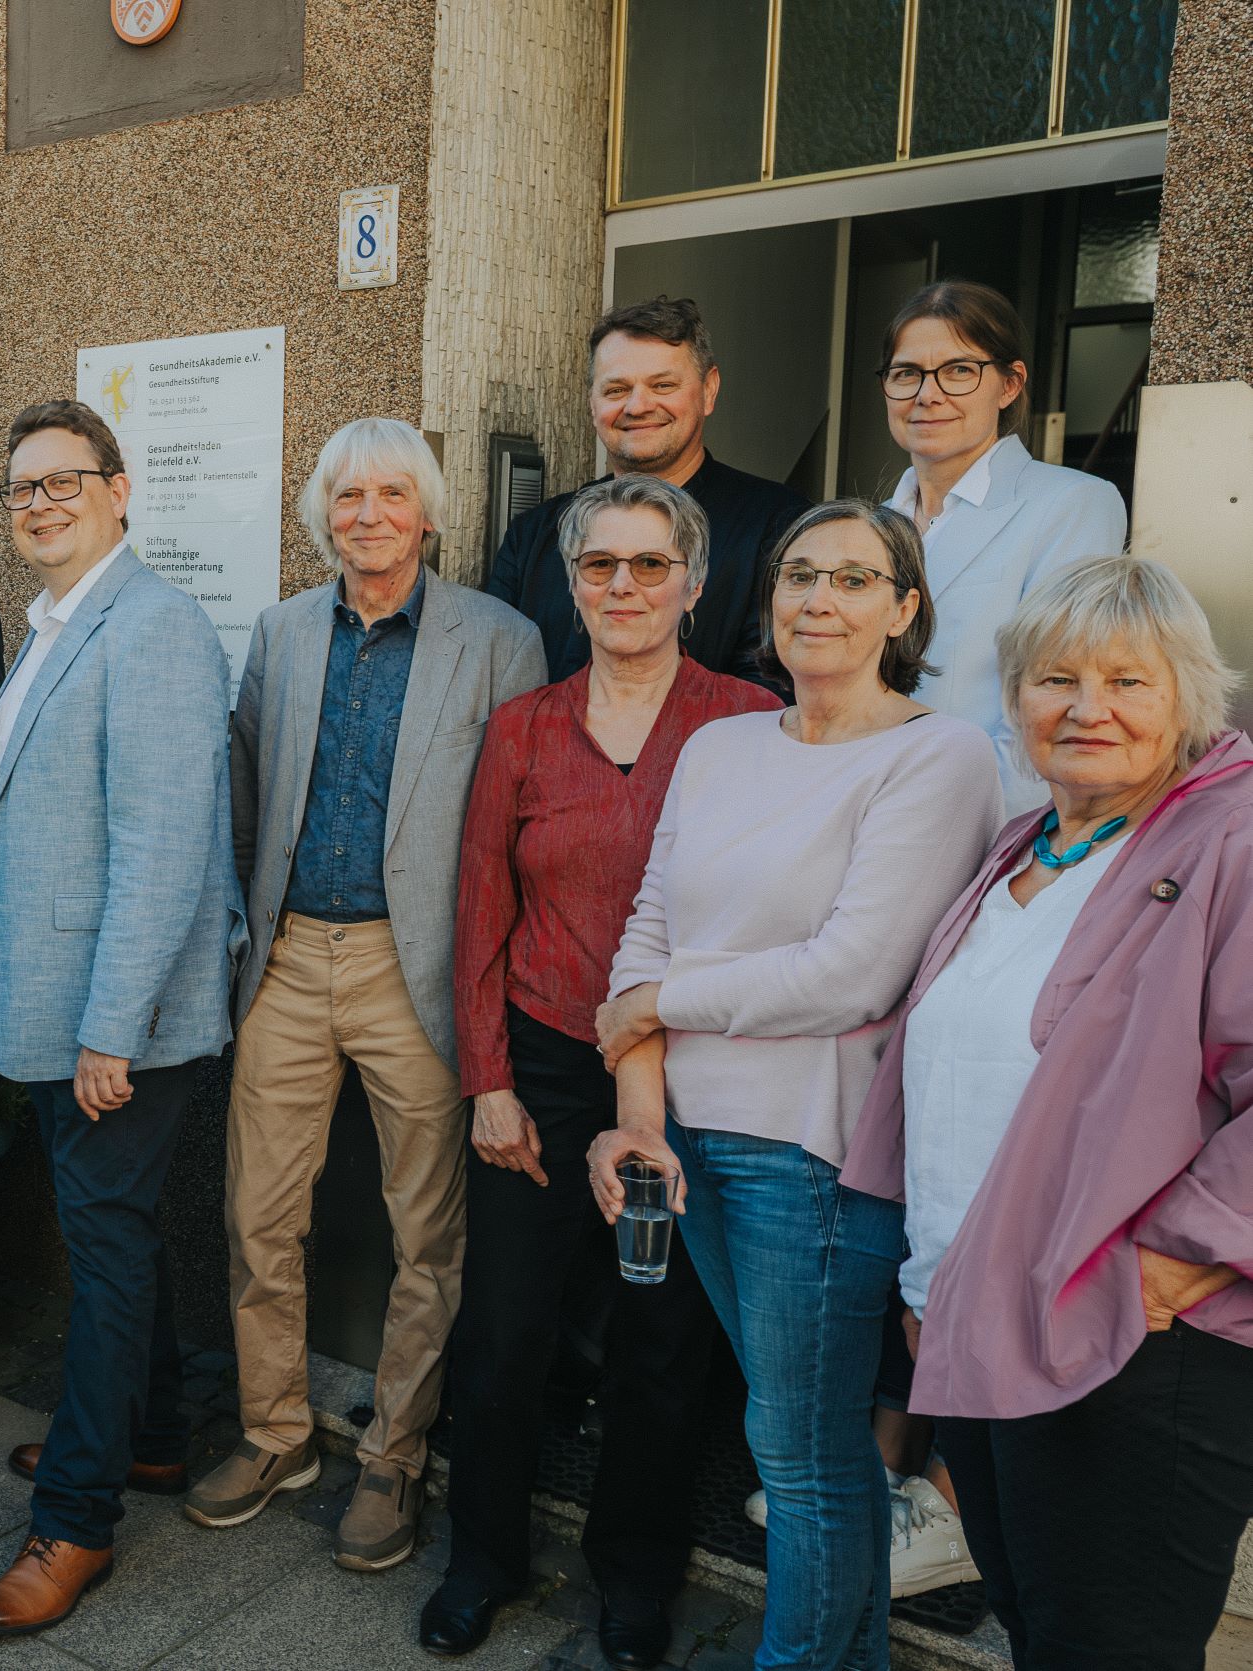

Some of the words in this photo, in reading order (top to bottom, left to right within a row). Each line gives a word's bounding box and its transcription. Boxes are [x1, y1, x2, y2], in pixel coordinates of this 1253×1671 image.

[357, 214, 376, 259] 8
[149, 354, 242, 372] GesundheitsAkademie
[244, 353, 261, 363] e.V.
[148, 376, 220, 389] GesundheitsStiftung
[147, 441, 222, 454] Gesundheitsladen
[147, 457, 183, 467] Bielefeld
[186, 456, 202, 465] e.V.
[147, 474, 176, 483] Gesunde
[178, 474, 197, 482] Stadt
[203, 471, 258, 481] Patientenstelle
[146, 536, 177, 547] Stiftung
[146, 549, 200, 561] Unabhängige
[200, 593, 232, 602] Bielefeld
